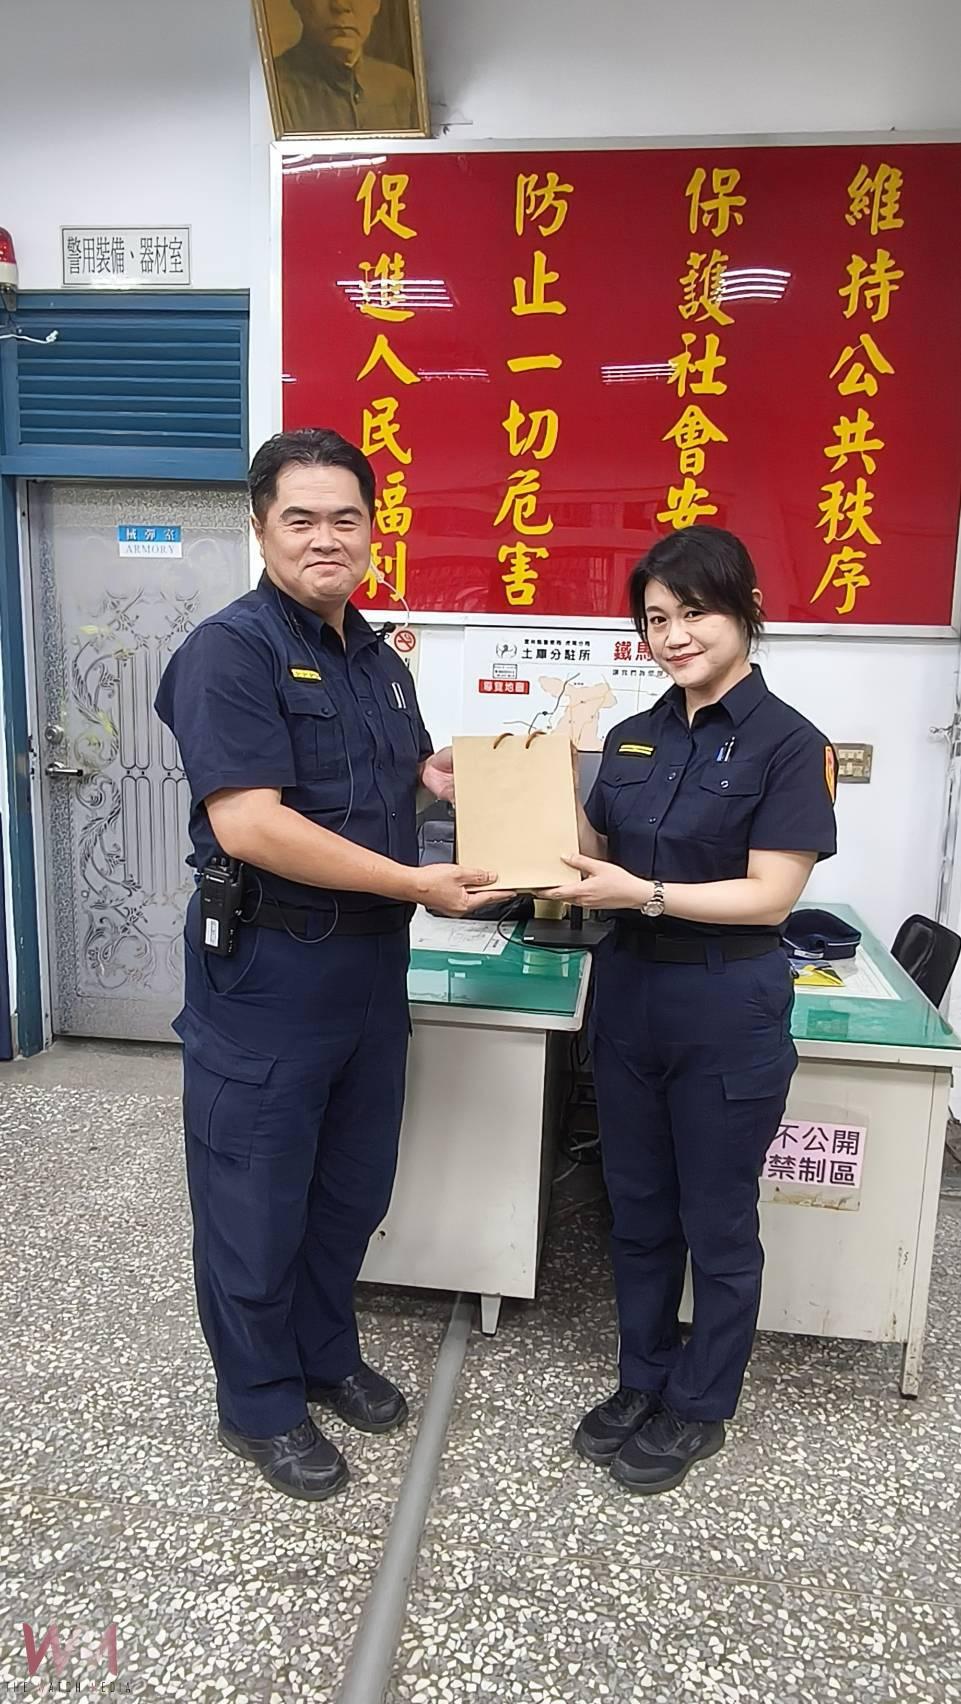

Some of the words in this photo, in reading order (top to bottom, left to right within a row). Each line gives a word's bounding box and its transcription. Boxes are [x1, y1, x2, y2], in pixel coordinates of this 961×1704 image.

[67, 236, 184, 275] 警用裝備、器材室
[355, 171, 420, 604] 促進人民福利
[494, 172, 574, 606] 防止一切危害
[810, 162, 905, 616] 維持公共秩序
[126, 544, 175, 554] ARMORY
[521, 648, 591, 661] 土庫分駐所
[775, 1123, 859, 1155] 不公開
[768, 1154, 857, 1186] 禁制區
